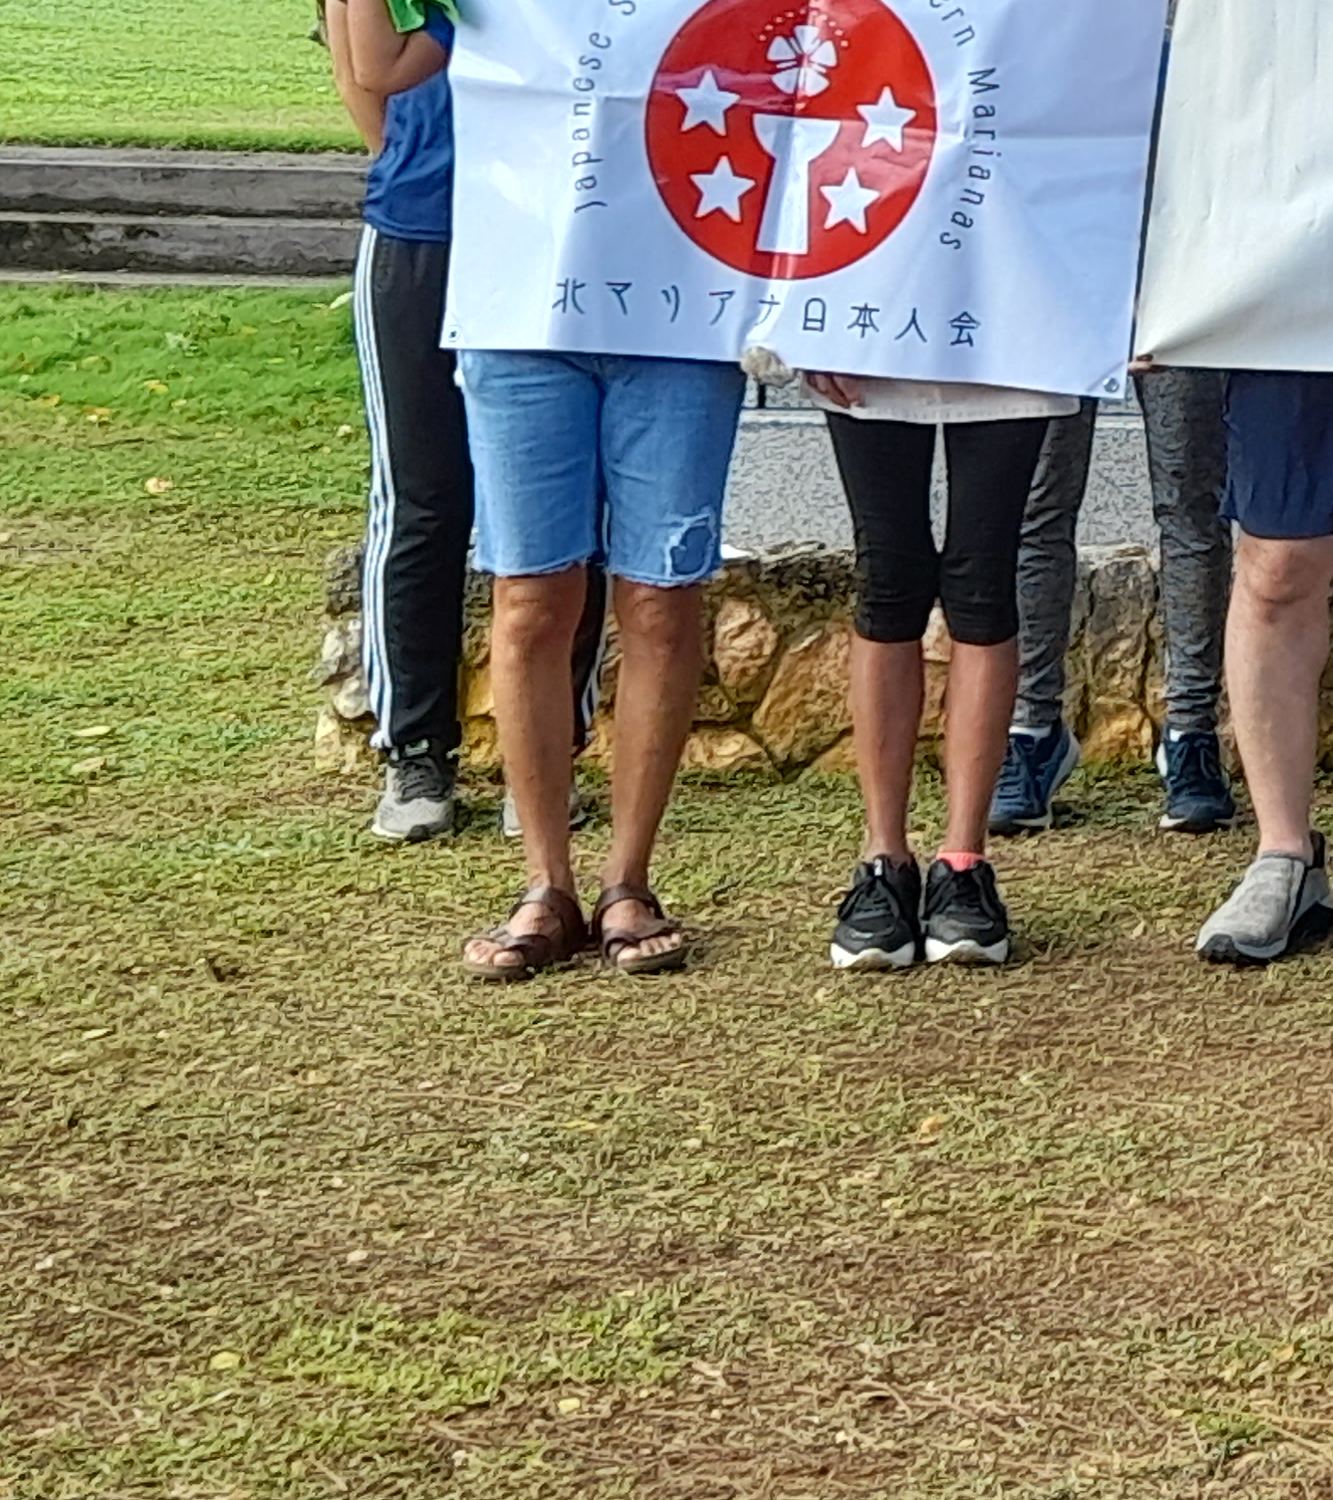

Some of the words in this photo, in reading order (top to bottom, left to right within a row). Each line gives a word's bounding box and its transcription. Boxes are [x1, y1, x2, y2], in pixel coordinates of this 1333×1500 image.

[572, 31, 609, 215] Japanese
[940, 67, 1002, 251] Marianas
[553, 277, 982, 349] 北マリアナ日本人会
